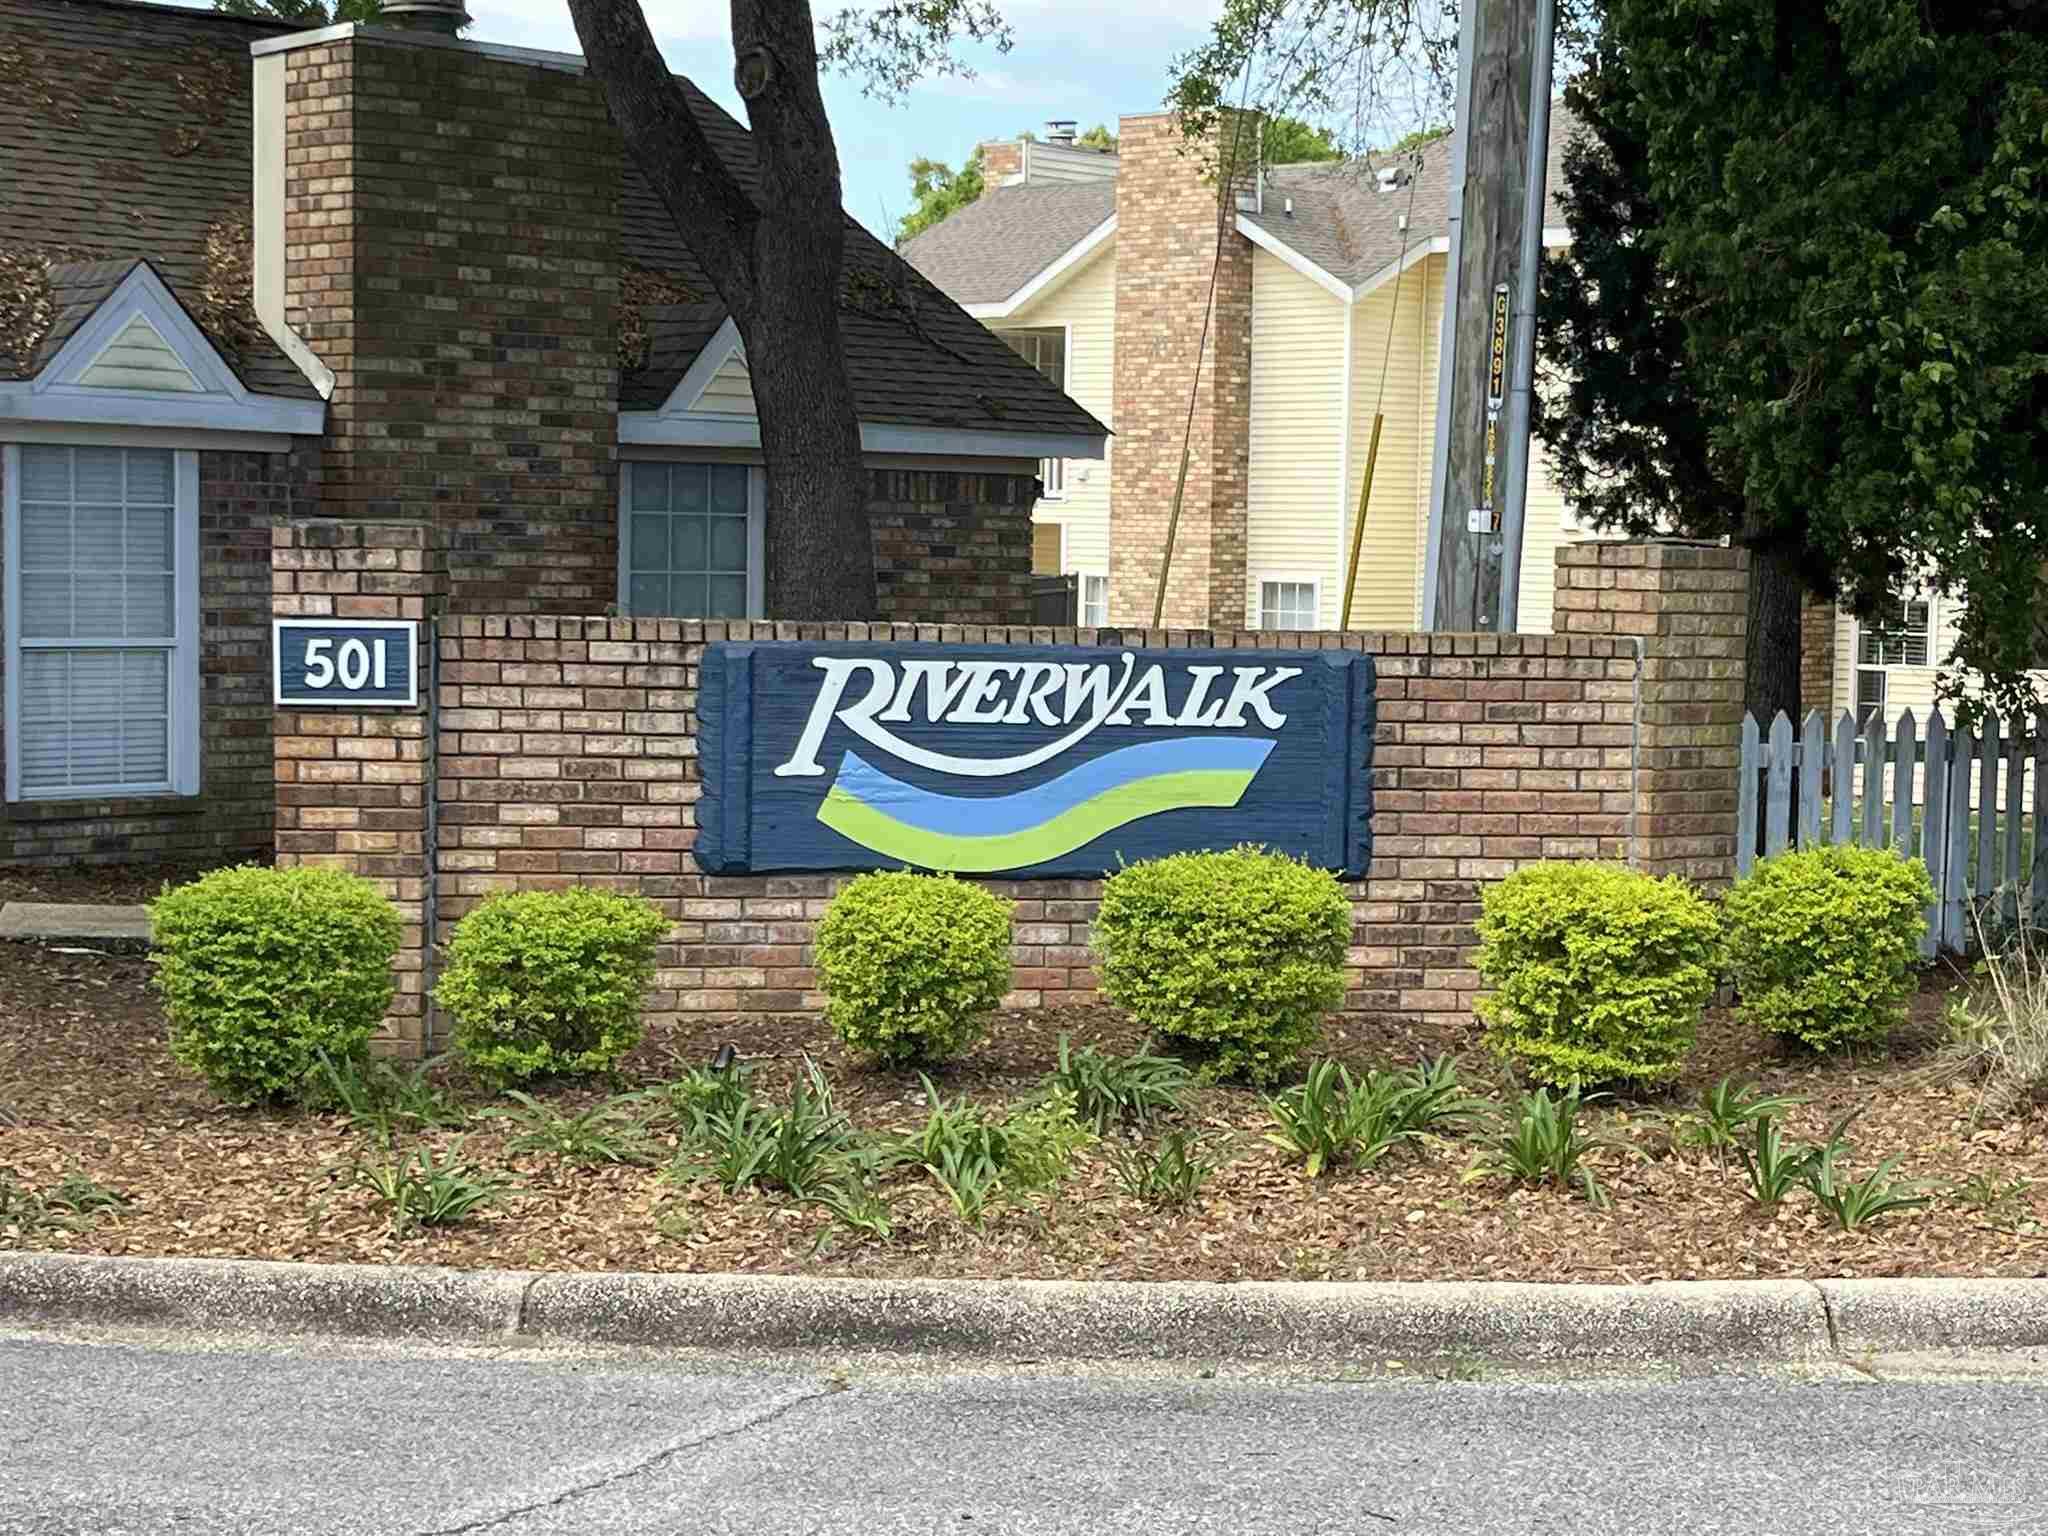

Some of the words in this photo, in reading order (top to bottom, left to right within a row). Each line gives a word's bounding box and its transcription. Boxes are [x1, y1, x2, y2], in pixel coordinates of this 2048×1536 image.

[1493, 295, 1506, 395] G3891
[304, 638, 386, 690] 501
[773, 652, 1303, 777] RIVERWALK
